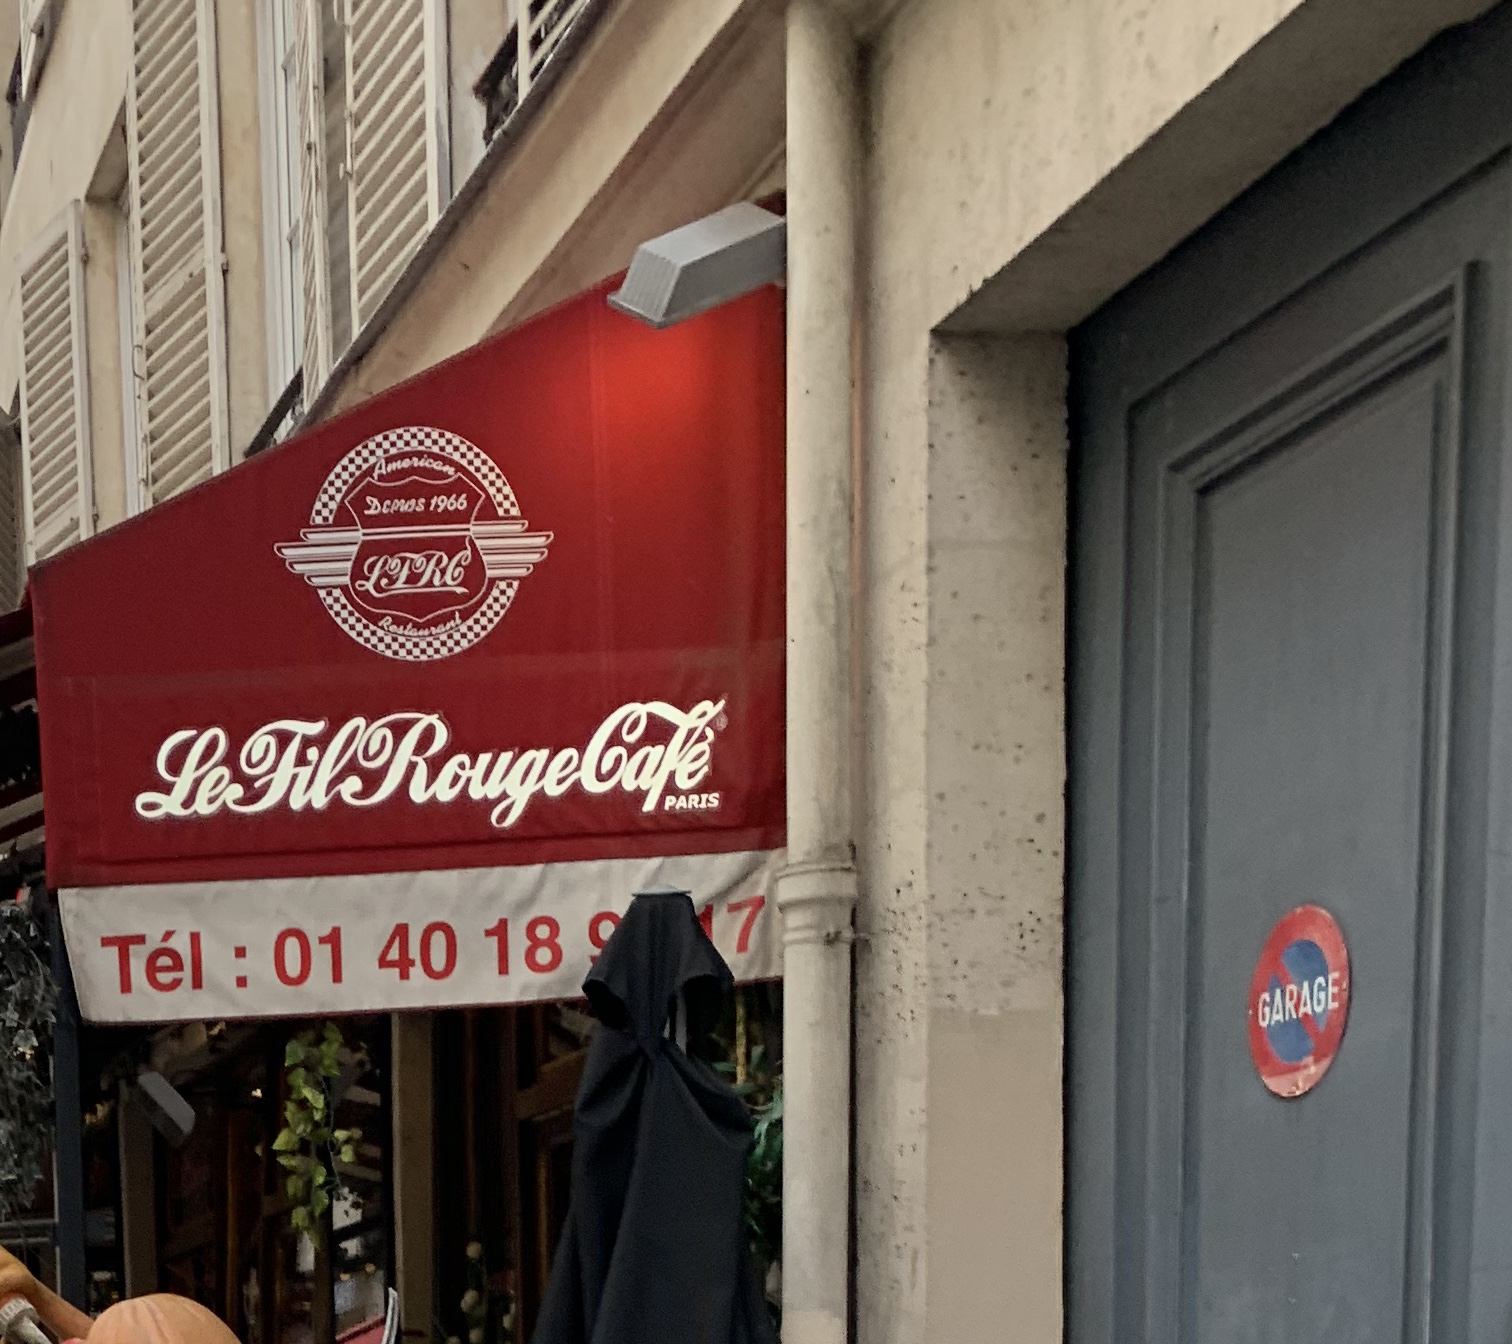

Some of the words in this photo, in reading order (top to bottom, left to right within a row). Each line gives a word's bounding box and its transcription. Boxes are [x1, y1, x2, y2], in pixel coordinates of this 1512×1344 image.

[372, 454, 456, 481] American
[429, 493, 468, 513] 1966
[377, 610, 463, 637] Restaurant
[664, 792, 720, 811] PARIS
[100, 929, 203, 995] Tél
[273, 926, 343, 987] 01
[378, 920, 458, 981] 40
[484, 915, 564, 976] 18
[1257, 971, 1341, 1028] GARAGE
